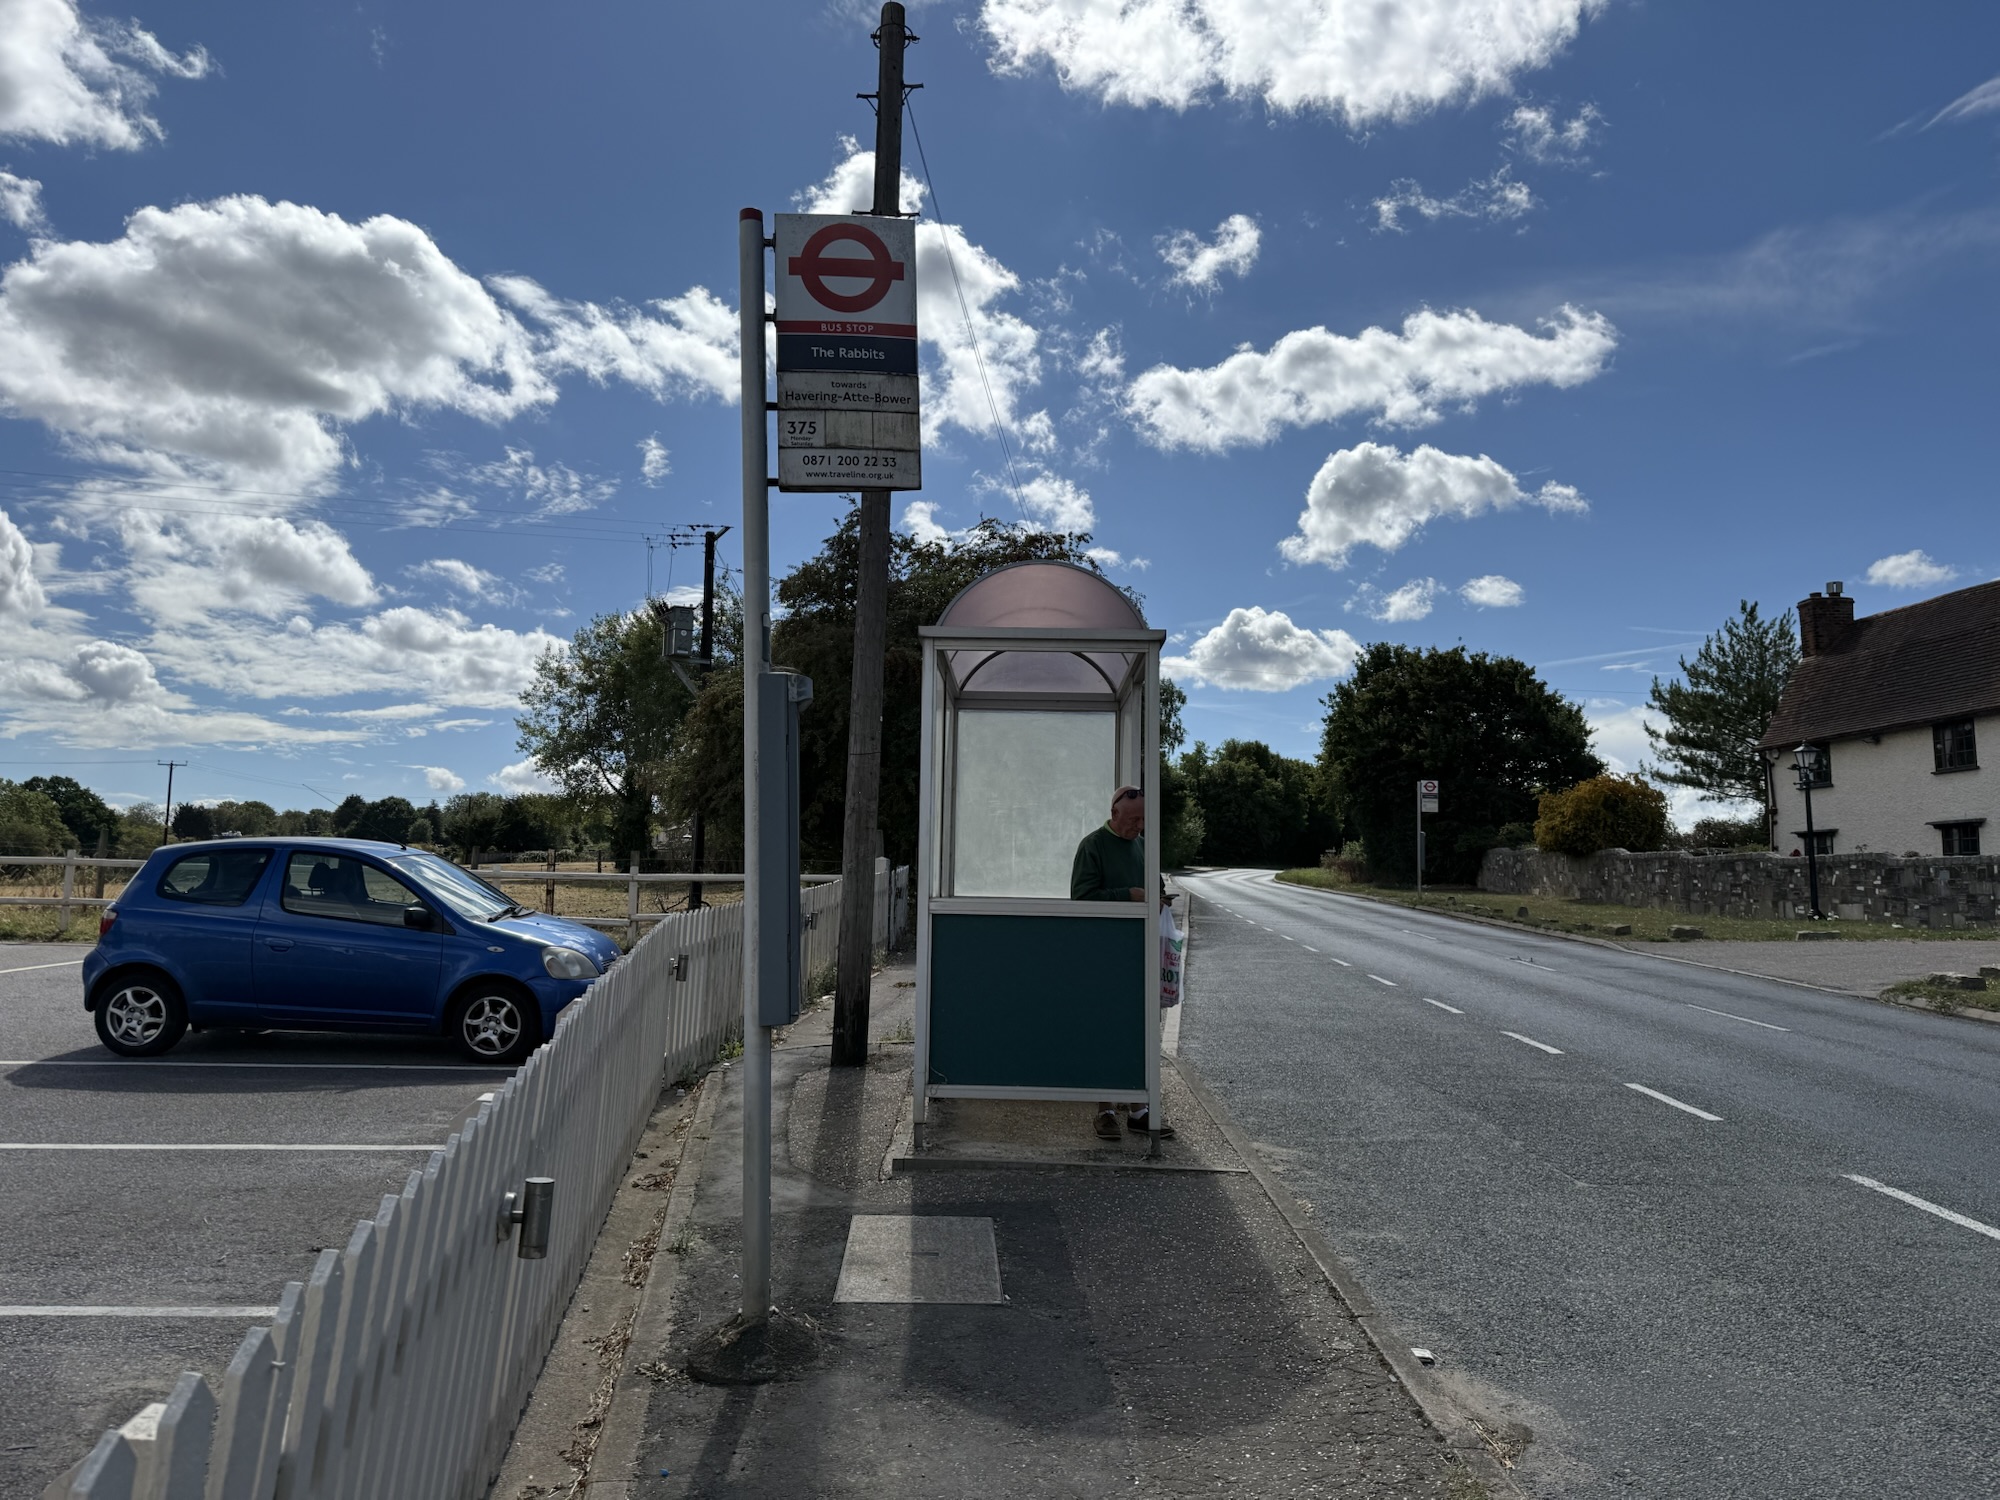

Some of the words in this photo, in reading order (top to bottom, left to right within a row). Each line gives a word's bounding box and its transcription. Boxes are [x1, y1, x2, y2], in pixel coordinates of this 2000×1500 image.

[821, 323, 842, 332] BUS
[846, 324, 874, 333] STOP
[811, 346, 835, 358] The
[839, 347, 885, 360] Rabbits
[831, 381, 867, 389] towards
[785, 391, 912, 405] Havering-Atte-Bower
[787, 421, 817, 435] 375
[802, 455, 832, 466] 0871
[837, 456, 860, 466] 200
[864, 457, 878, 467] 22
[882, 457, 897, 467] 33
[805, 471, 894, 481] www.traveline.org.uk
